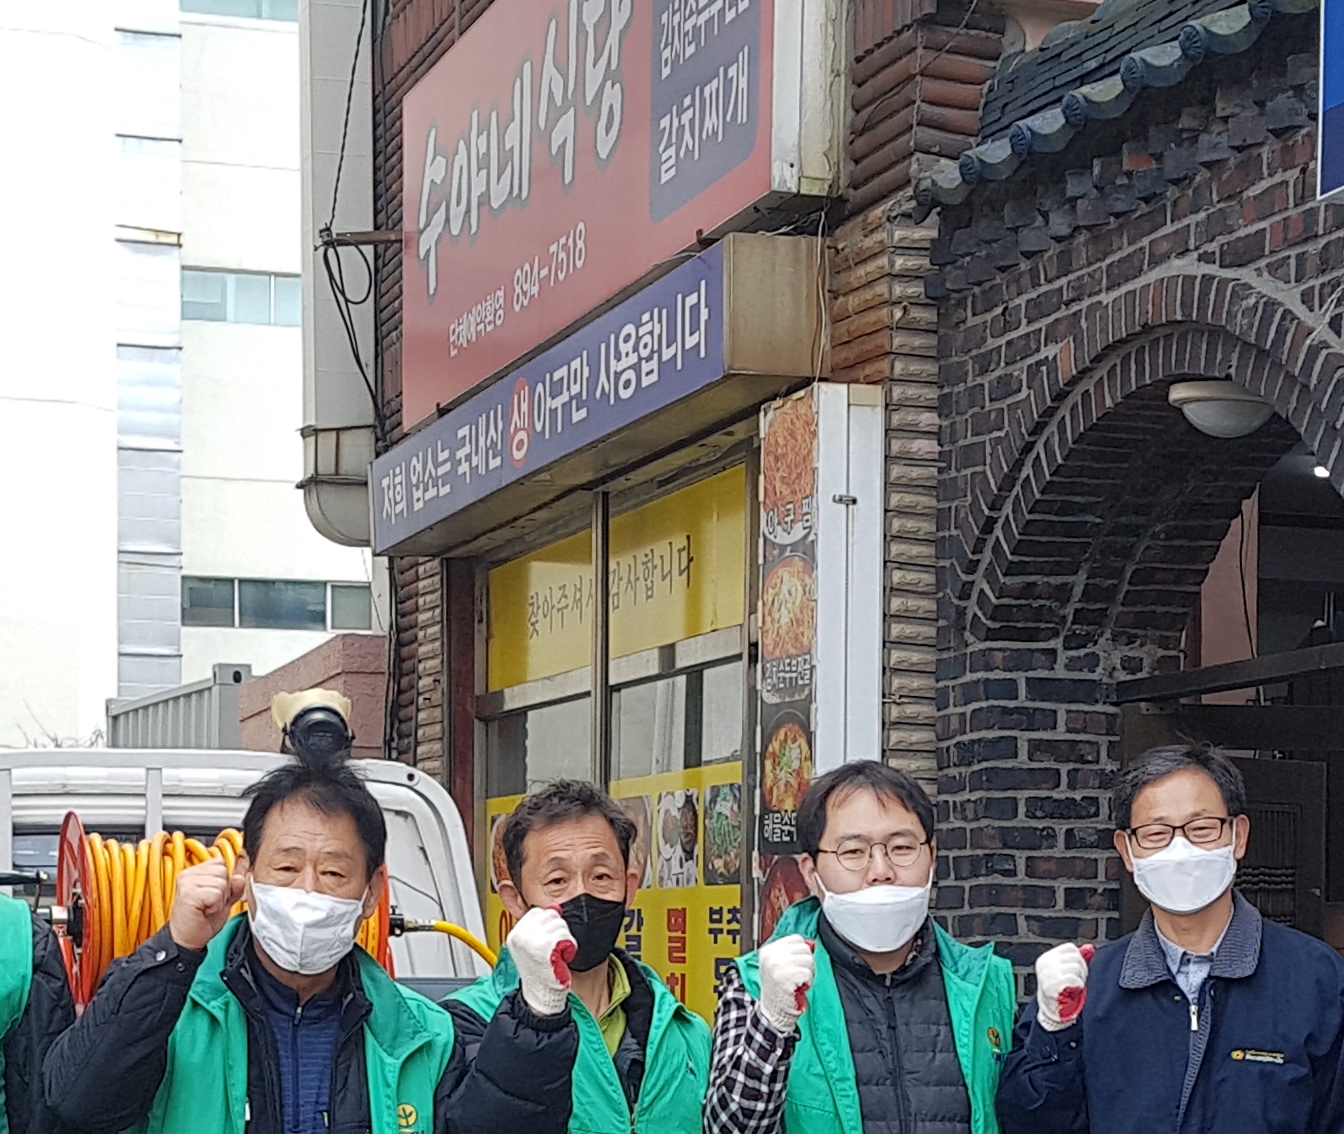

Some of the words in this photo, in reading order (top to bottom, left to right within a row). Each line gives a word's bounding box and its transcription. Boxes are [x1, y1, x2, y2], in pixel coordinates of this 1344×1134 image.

[419, 61, 532, 296] 수야네
[538, 0, 631, 185] 식당
[513, 221, 586, 313] 894-7518
[382, 462, 407, 525] 저희
[410, 440, 451, 512] 업소는
[456, 404, 503, 484] 국내산
[510, 385, 529, 461] 생
[534, 350, 589, 440] 아구만
[595, 279, 709, 405] 사용합니다
[609, 534, 694, 614] 감사합니다
